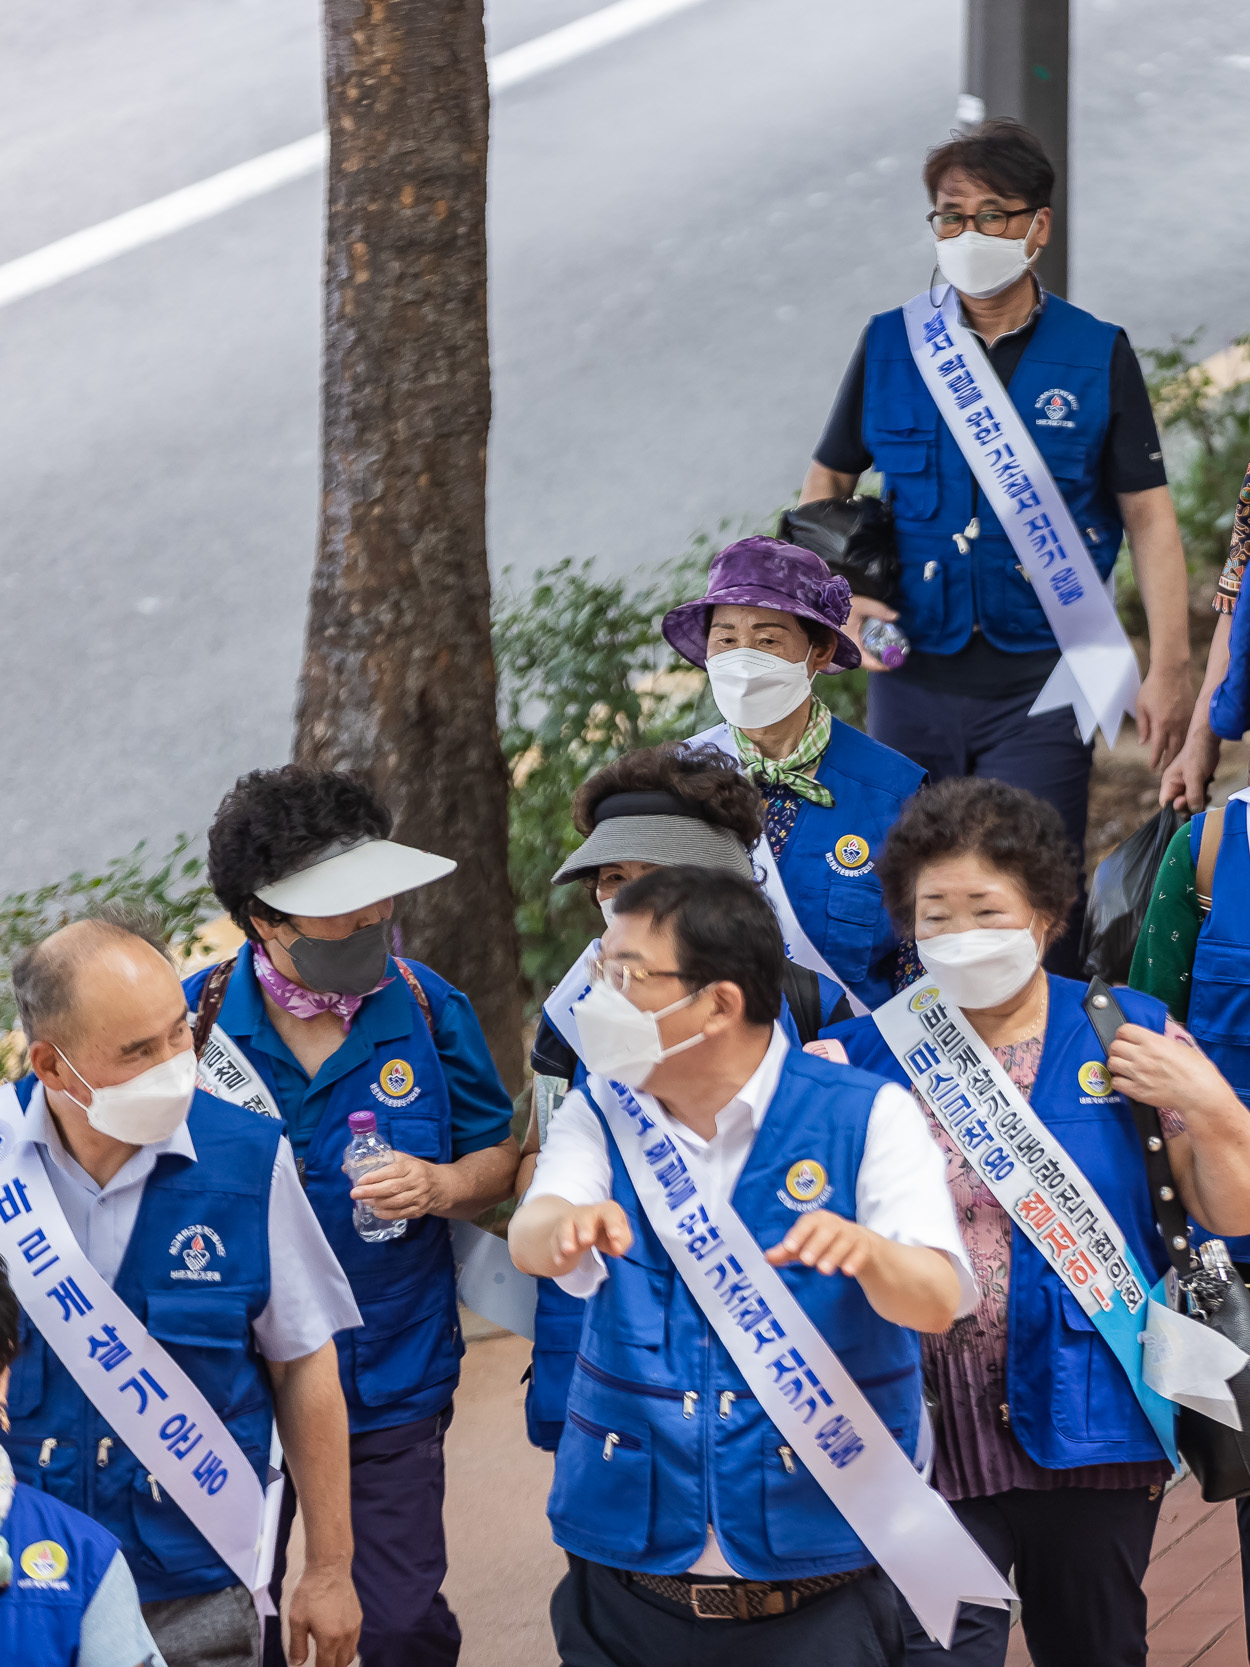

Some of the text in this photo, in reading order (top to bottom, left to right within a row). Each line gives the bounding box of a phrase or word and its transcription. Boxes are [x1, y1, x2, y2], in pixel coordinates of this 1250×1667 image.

[936, 353, 984, 410] 확립을
[965, 406, 1003, 447] 위한
[985, 441, 1041, 515] 기초질서
[1022, 513, 1067, 569] 지키기
[1049, 566, 1085, 607] 운동
[903, 1038, 1015, 1183] 마스크착용
[919, 1002, 1146, 1315] 바르게살기운동광진구협의회
[643, 1132, 869, 1471] 확립을 위한 기초질서 지키기 운동
